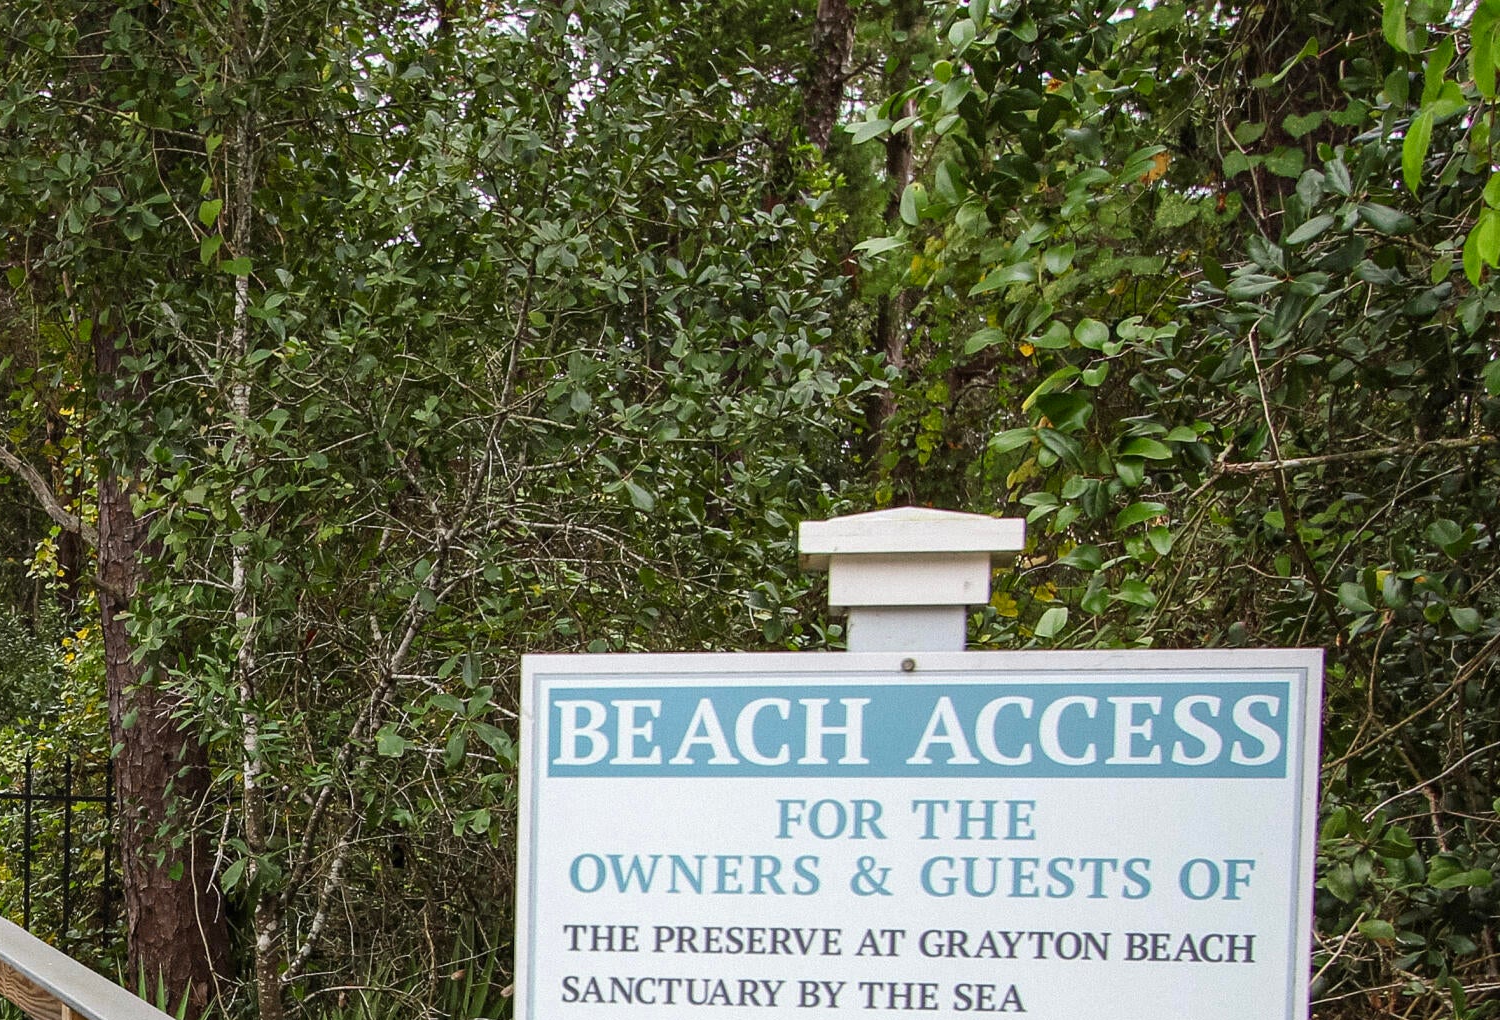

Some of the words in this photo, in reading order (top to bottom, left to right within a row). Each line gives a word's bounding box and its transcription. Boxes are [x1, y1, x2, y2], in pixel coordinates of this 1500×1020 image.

[552, 697, 871, 765] BEACH
[905, 694, 1280, 765] ACCESS
[775, 798, 887, 839] FOR
[911, 799, 1036, 840] THE
[569, 853, 820, 895] OWNERS
[850, 855, 893, 896] &
[920, 855, 1151, 899] GUESTS
[1178, 857, 1256, 900] OF
[563, 924, 638, 952] THE
[652, 925, 841, 955] PRESERVE
[855, 928, 906, 956] AT
[919, 929, 1111, 960] GRAYTON
[1123, 932, 1256, 963] BEACH
[561, 975, 785, 1007] SANCTUARY
[797, 980, 846, 1008] BY
[858, 981, 938, 1010] THE
[953, 983, 1026, 1012] SEA
